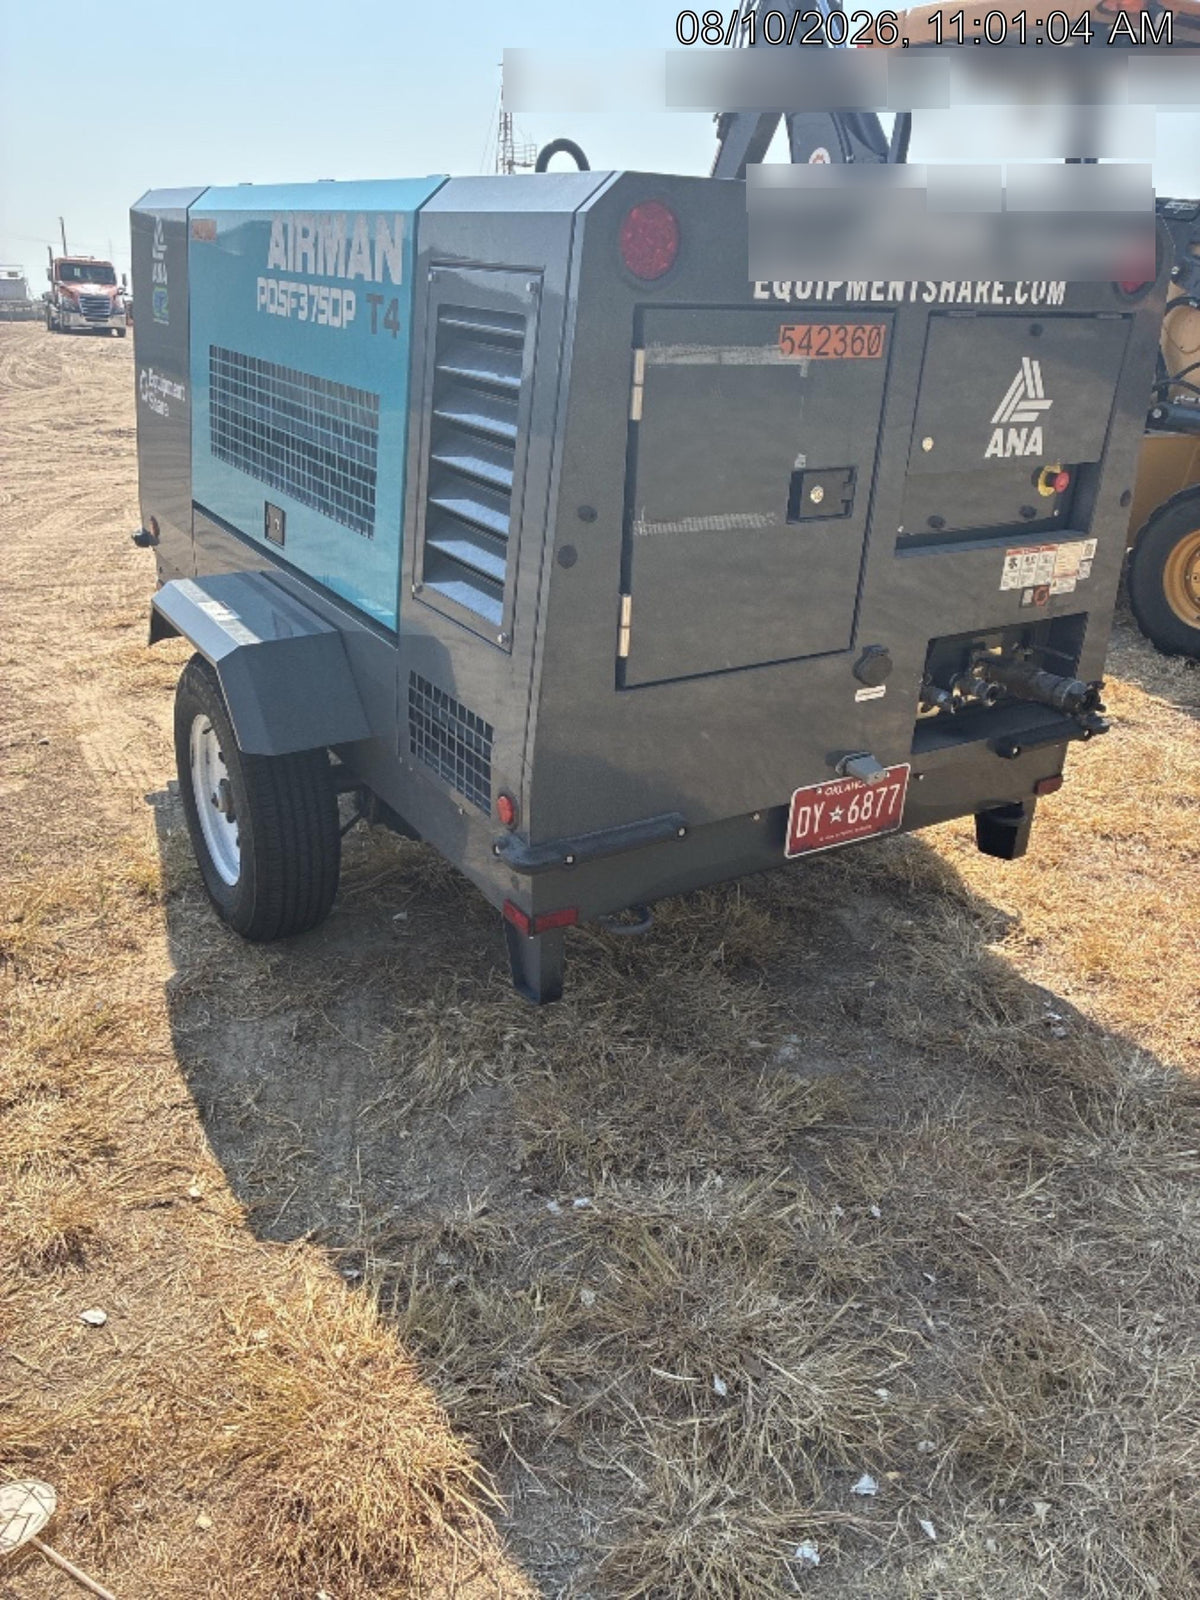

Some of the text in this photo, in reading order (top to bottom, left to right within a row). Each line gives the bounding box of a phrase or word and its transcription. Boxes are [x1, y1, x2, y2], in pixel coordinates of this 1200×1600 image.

[267, 210, 404, 285] AIRMAN
[366, 293, 400, 340] T4
[781, 326, 882, 356] 542360
[984, 426, 1043, 458] ANA
[796, 801, 826, 838] DY
[847, 783, 901, 824] 6877
